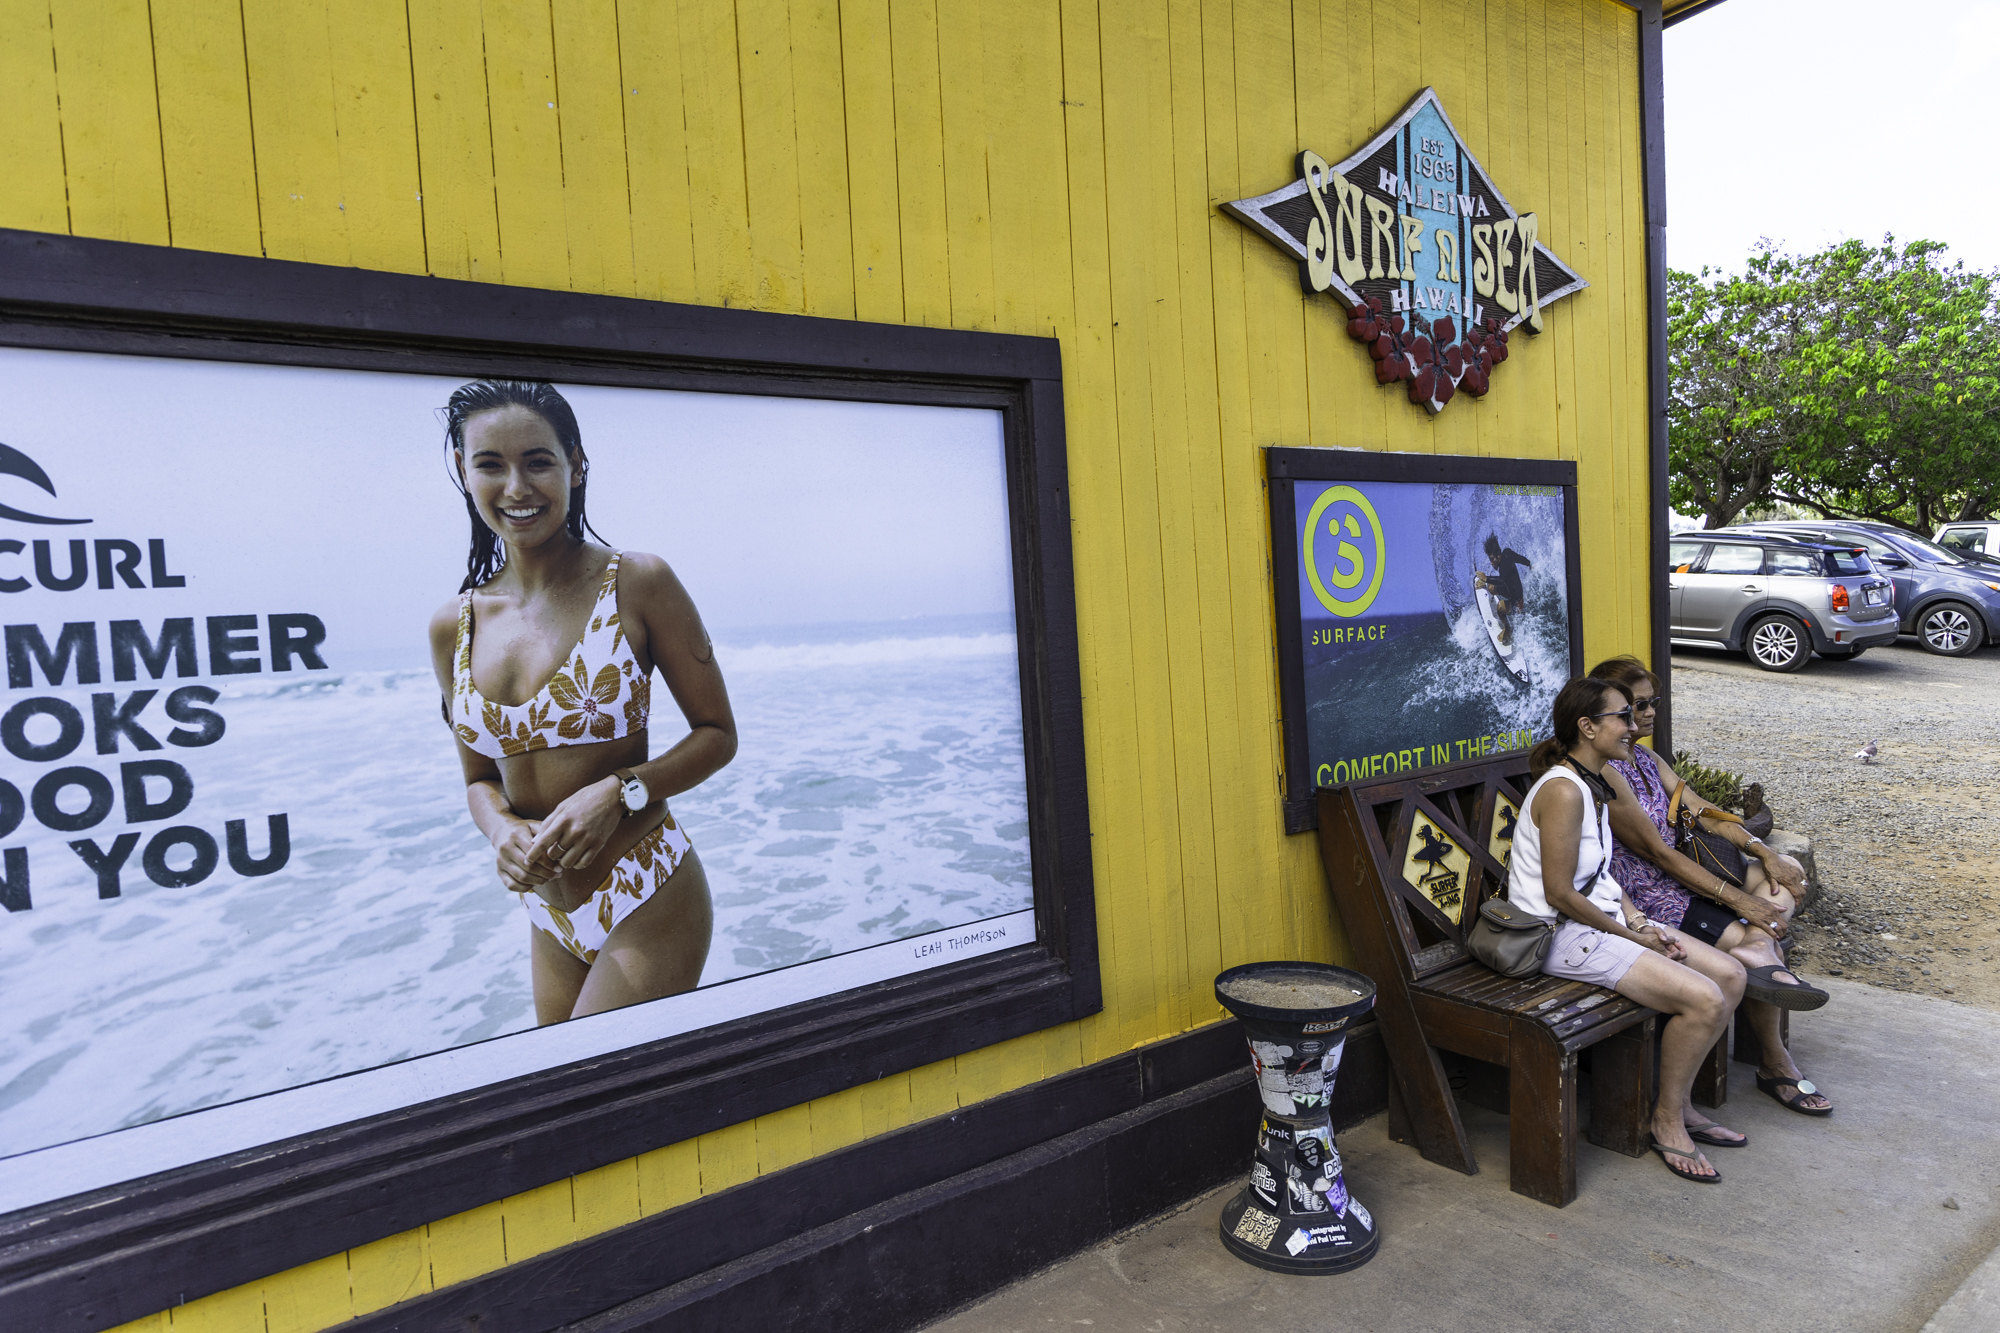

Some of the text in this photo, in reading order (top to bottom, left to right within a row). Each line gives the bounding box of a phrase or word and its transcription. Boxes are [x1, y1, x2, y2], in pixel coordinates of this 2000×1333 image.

[1421, 137, 1444, 157] EST
[1415, 153, 1457, 182] 1965
[1378, 167, 1490, 217] HALEIWA
[1303, 150, 1425, 293] SURF
[1472, 212, 1544, 332] SEA
[1389, 287, 1485, 326] HAWAII
[1519, 485, 1558, 497] CRAWFORD
[4, 613, 328, 689] MMER
[1312, 625, 1387, 646] SURFACE
[0, 685, 226, 762] OKS
[1317, 728, 1532, 787] COMFORT IN THE SUN
[66, 812, 291, 900] YOU
[1430, 877, 1458, 894] SURFER
[914, 927, 1006, 958] LEAH THOMPSON
[1239, 1218, 1274, 1240] FURY
